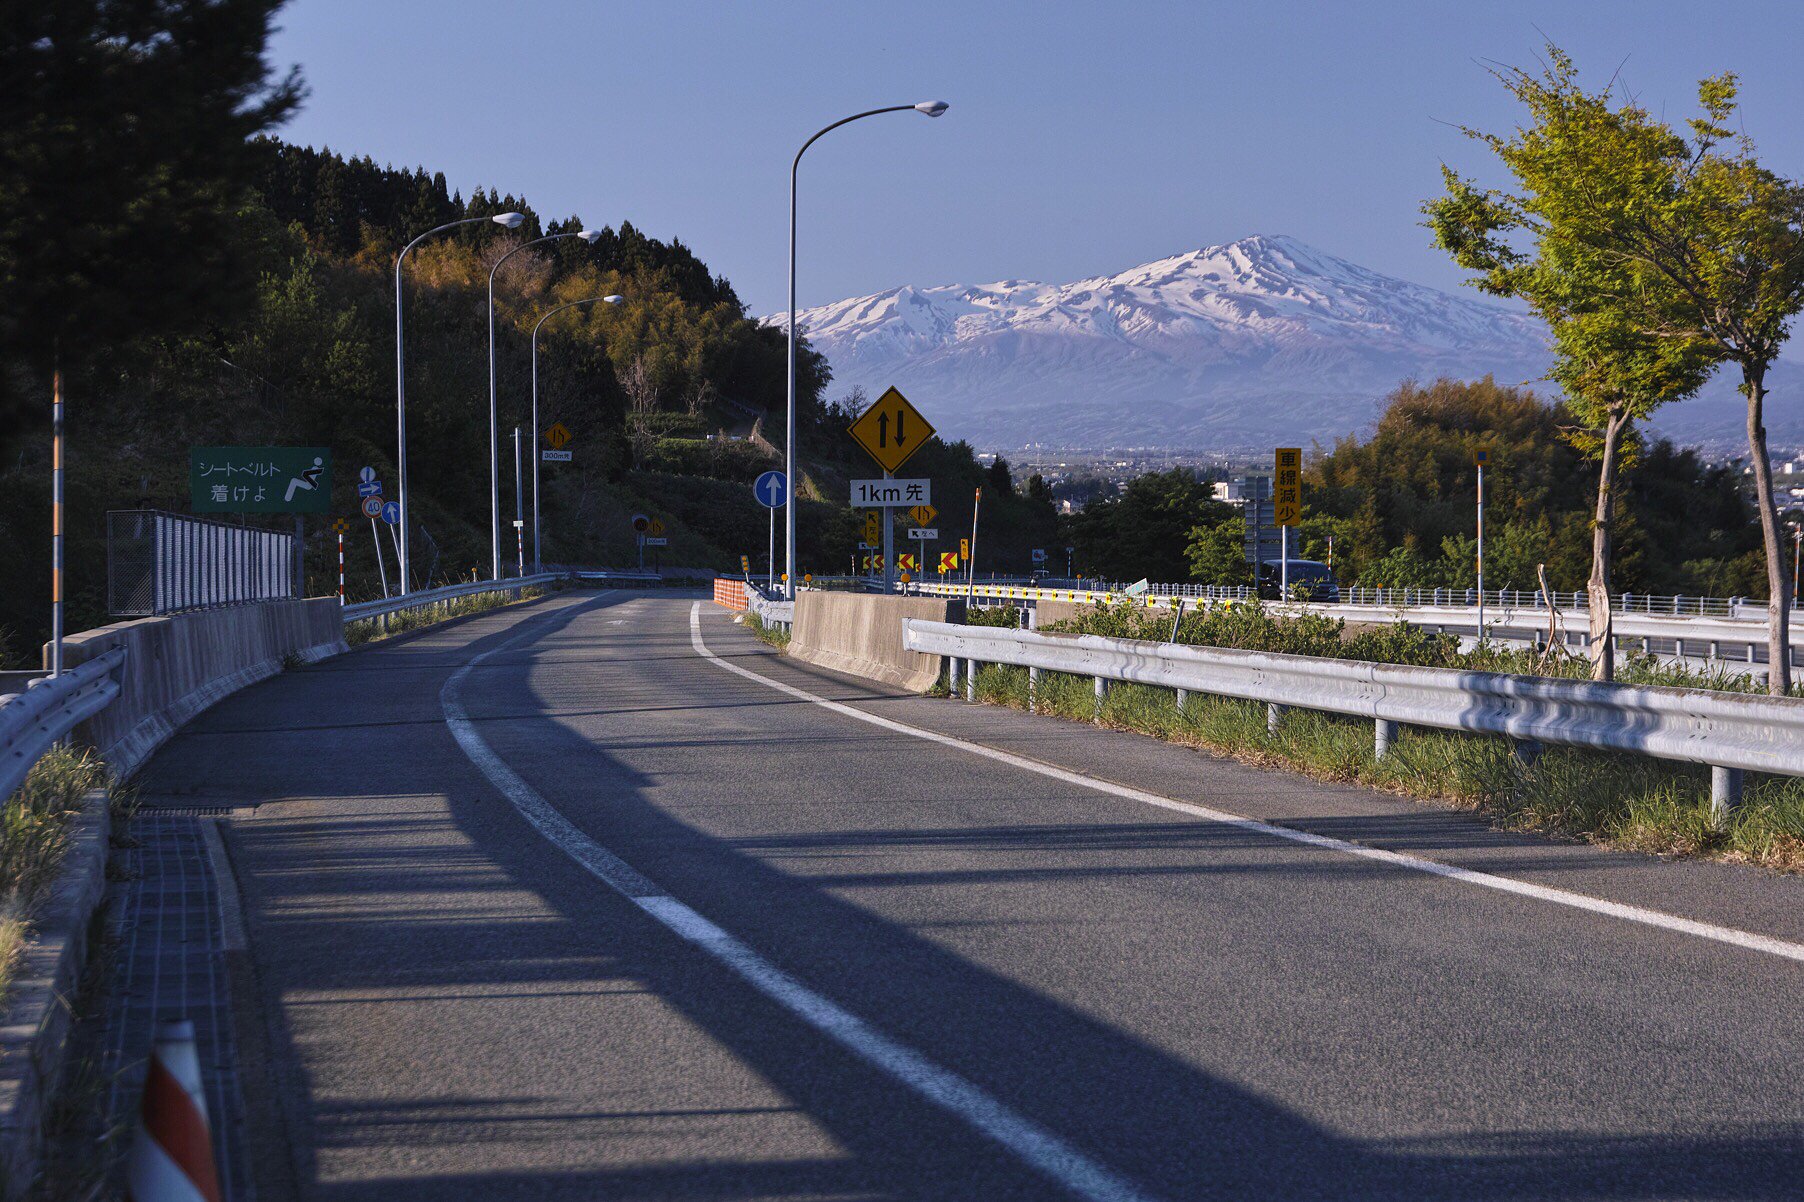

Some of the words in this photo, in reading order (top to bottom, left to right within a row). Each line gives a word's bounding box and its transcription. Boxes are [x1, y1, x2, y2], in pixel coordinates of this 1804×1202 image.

[200, 461, 281, 477] シートベルト
[210, 484, 266, 502] 着けよ
[858, 484, 900, 502] 1km
[906, 483, 923, 501] 先
[1279, 451, 1296, 522] 車線減少
[368, 501, 380, 512] 40
